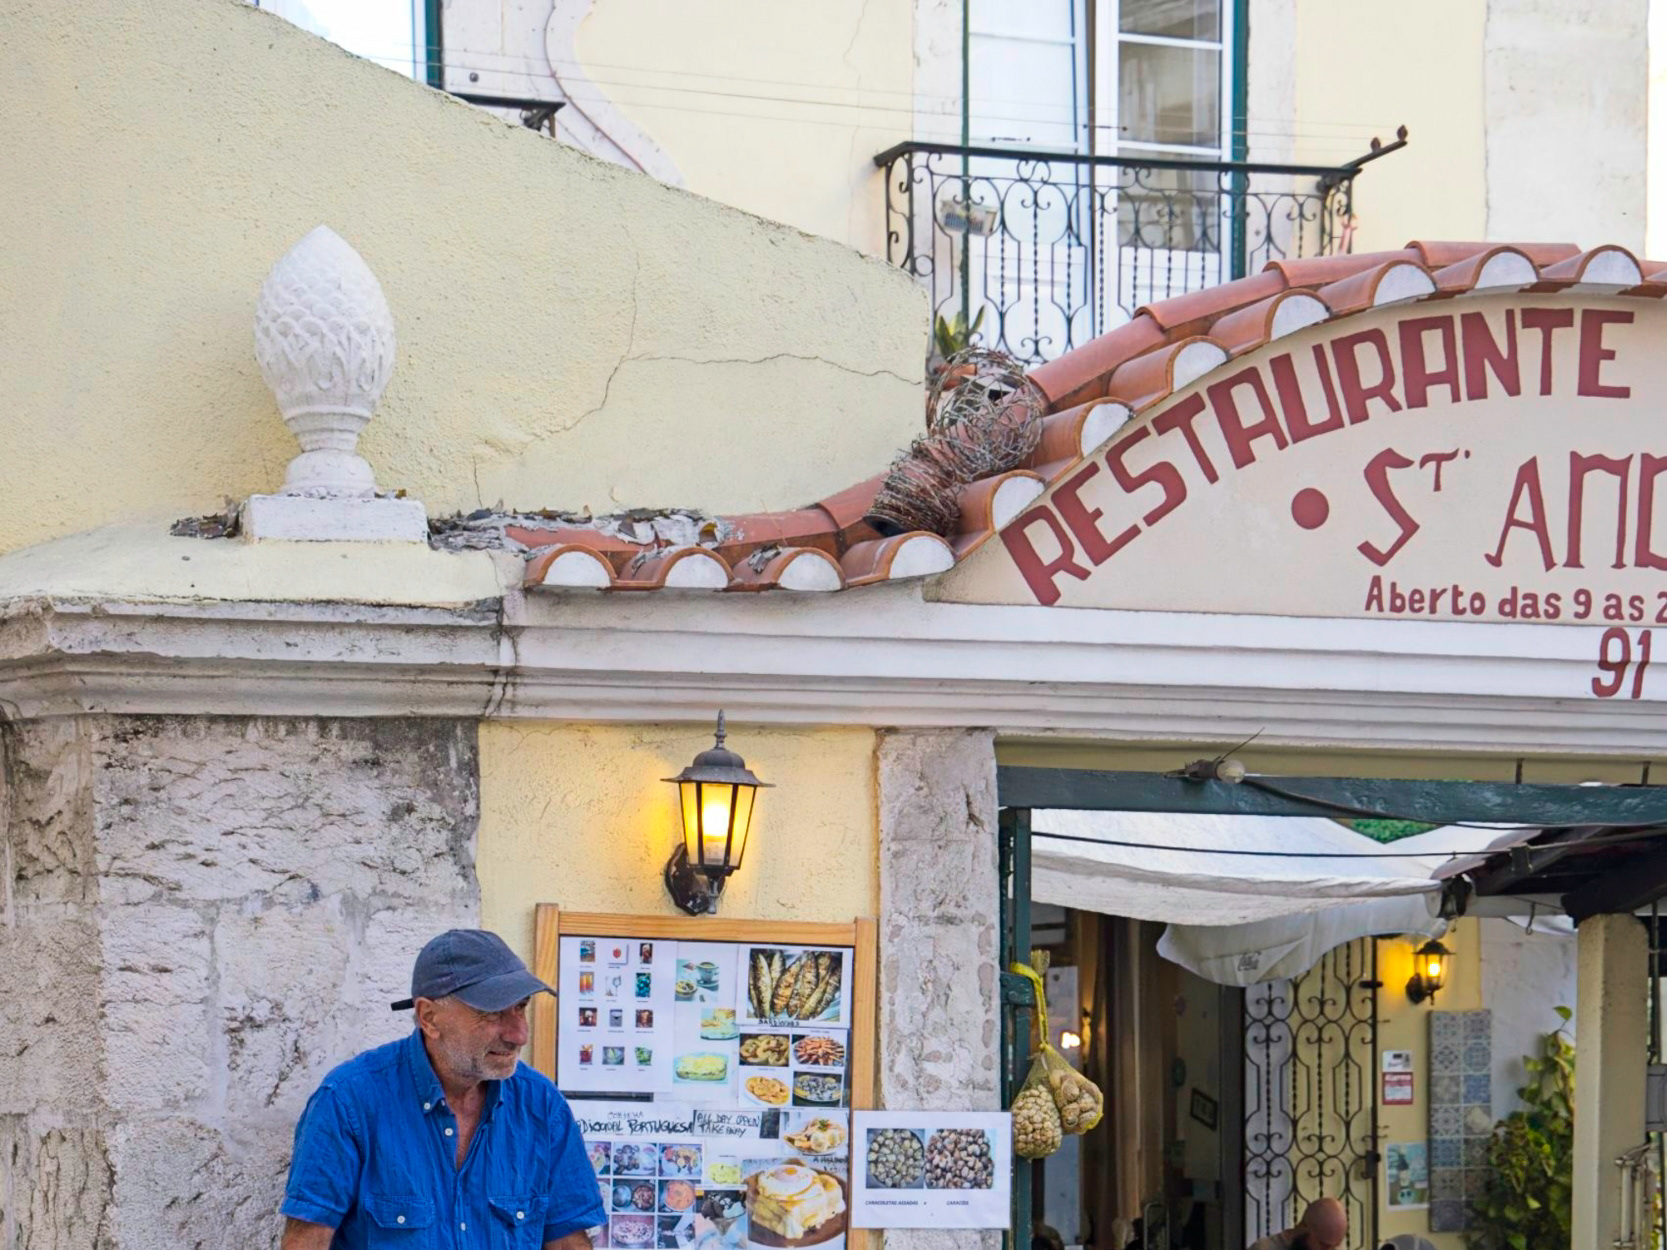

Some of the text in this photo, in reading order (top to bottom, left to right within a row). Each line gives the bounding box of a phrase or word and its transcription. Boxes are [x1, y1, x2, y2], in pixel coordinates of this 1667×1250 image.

[1000, 307, 1635, 607] RESTAURANTE
[1364, 575, 1486, 616] Aberto
[1498, 586, 1562, 620] das
[1573, 588, 1593, 620] 9
[1602, 592, 1645, 622] as
[1591, 626, 1653, 700] 91
